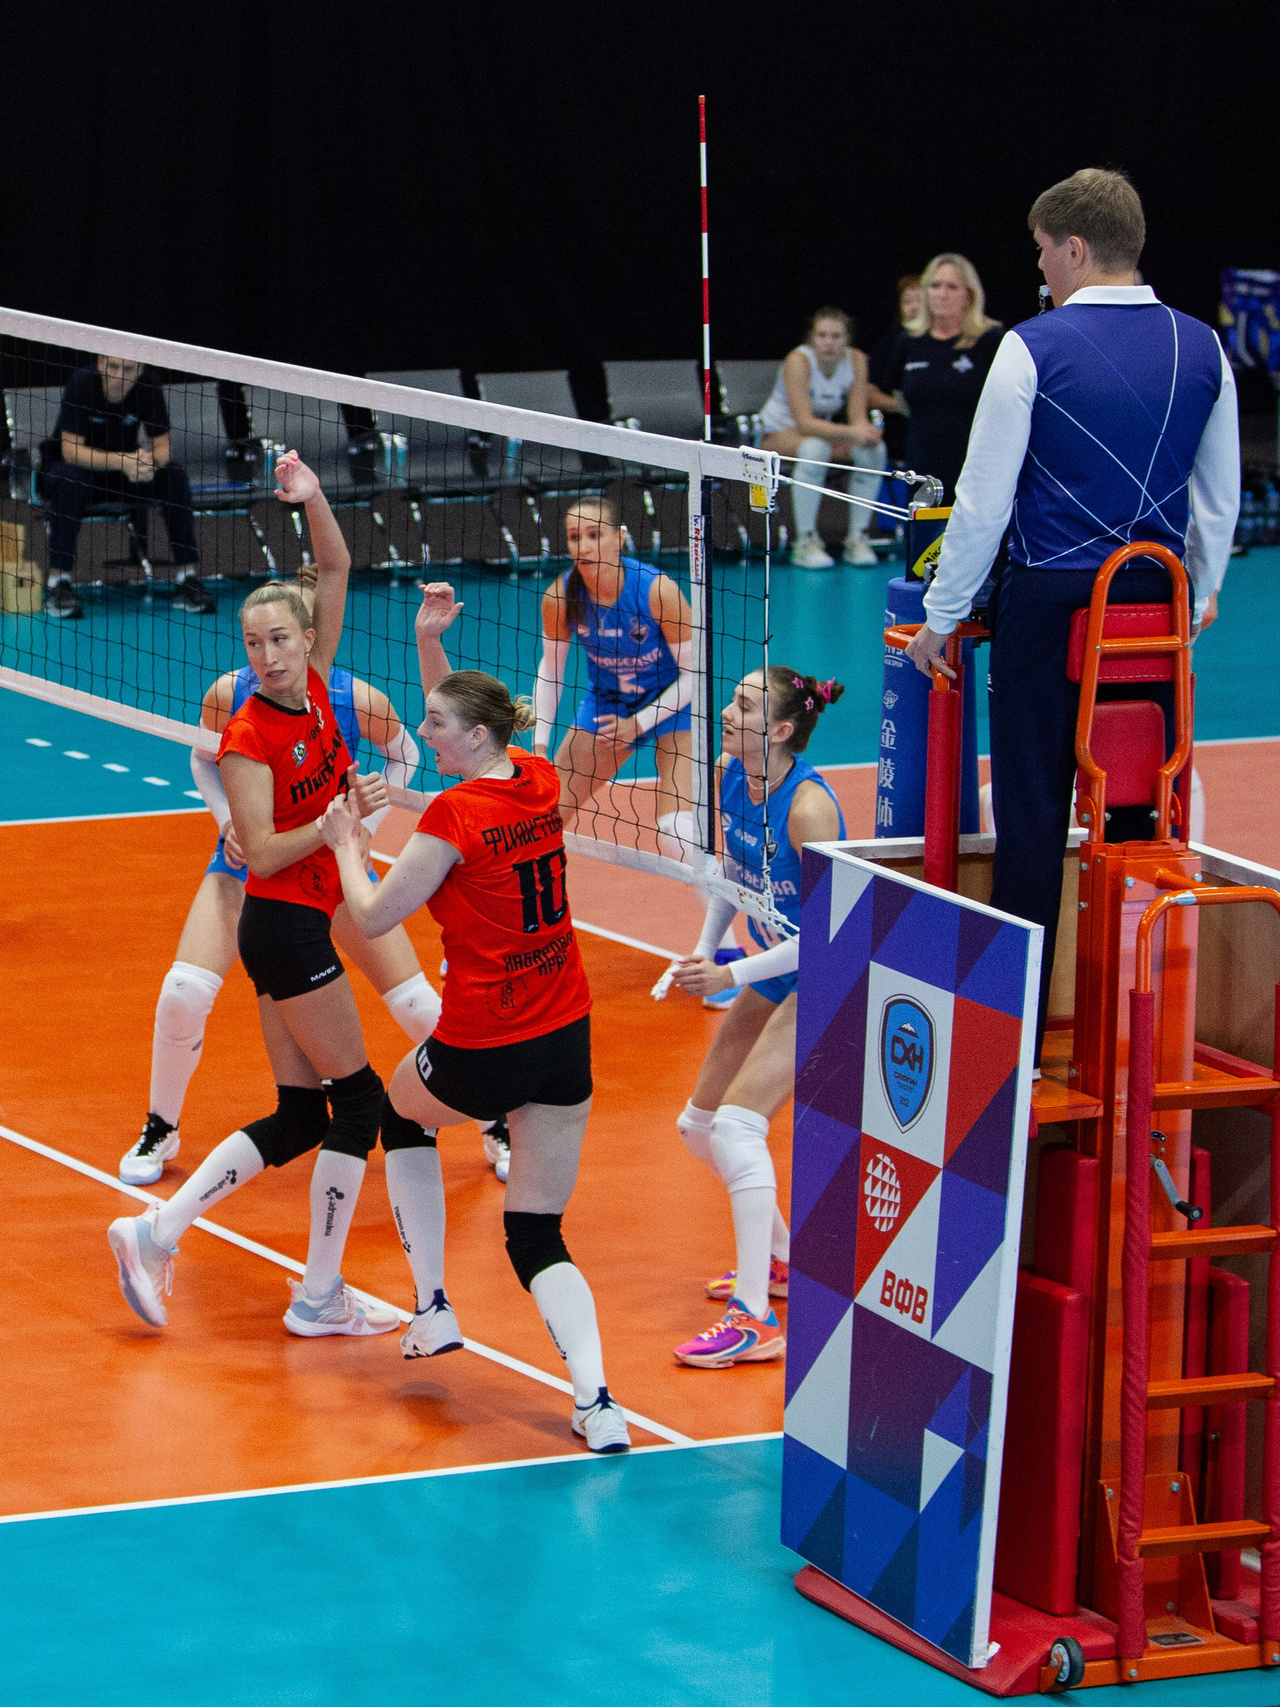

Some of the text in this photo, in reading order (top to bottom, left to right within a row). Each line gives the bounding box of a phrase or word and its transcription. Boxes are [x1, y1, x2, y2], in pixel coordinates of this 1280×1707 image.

[512, 846, 568, 934] 10
[310, 965, 336, 983] MAVEX
[879, 1269, 928, 1325] ВФВ
